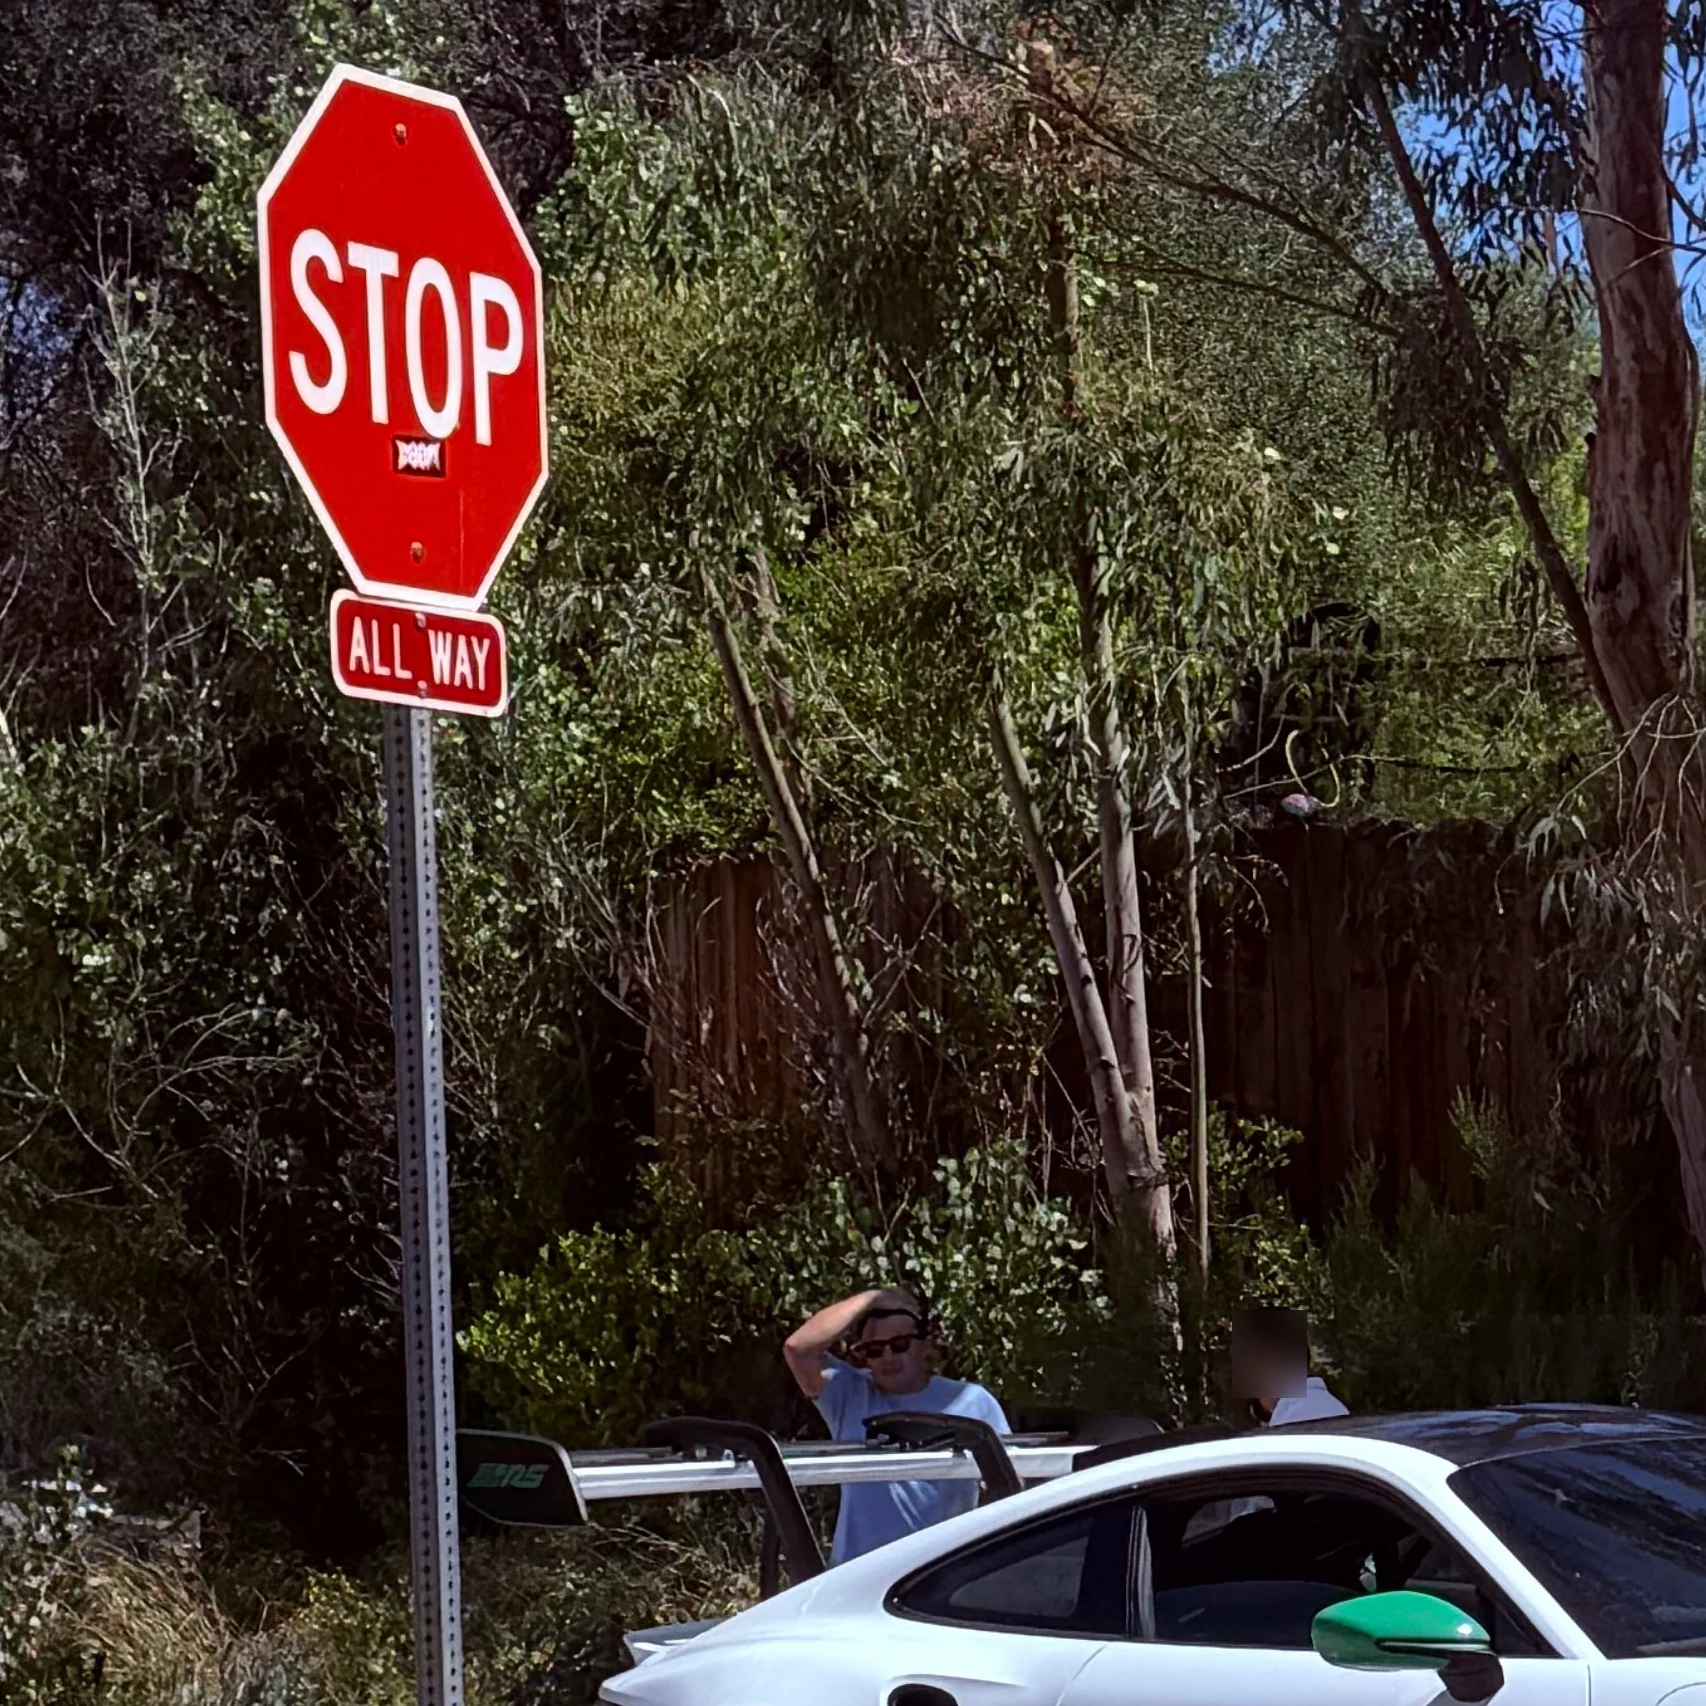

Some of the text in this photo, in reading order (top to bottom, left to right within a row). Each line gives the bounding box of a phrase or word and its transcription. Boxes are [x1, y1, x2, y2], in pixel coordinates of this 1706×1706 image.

[288, 228, 524, 446] STOP
[348, 615, 492, 692] ALL WAY
